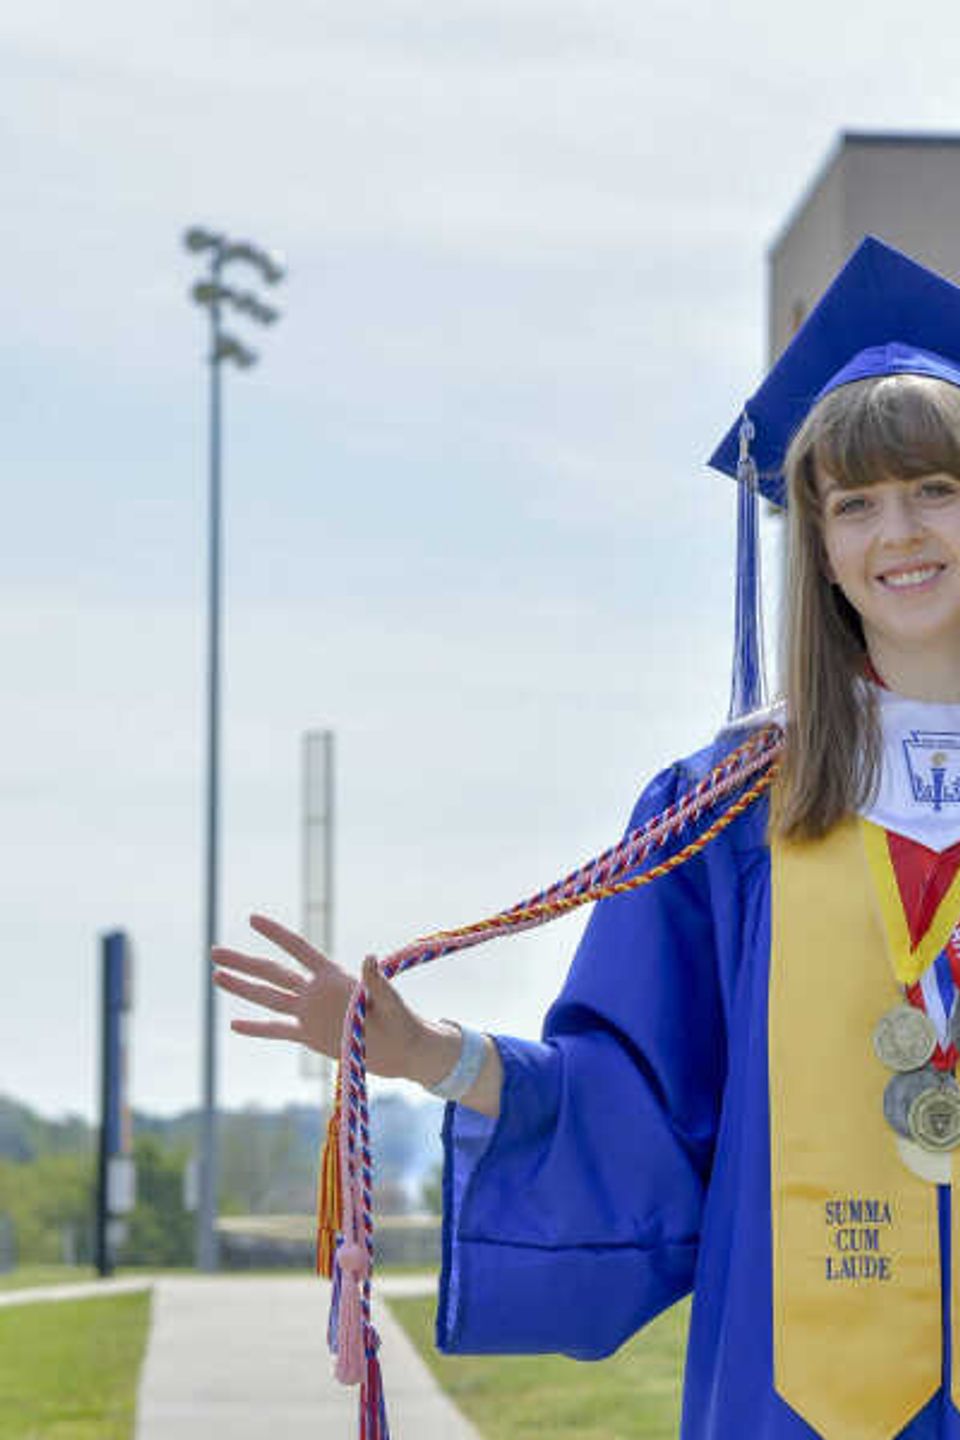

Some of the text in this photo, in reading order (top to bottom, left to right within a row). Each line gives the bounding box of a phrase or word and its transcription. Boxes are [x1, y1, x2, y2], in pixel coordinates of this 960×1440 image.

[825, 1199, 892, 1225] SUMMA
[836, 1227, 880, 1252] CUM
[825, 1254, 892, 1281] LAUDE
